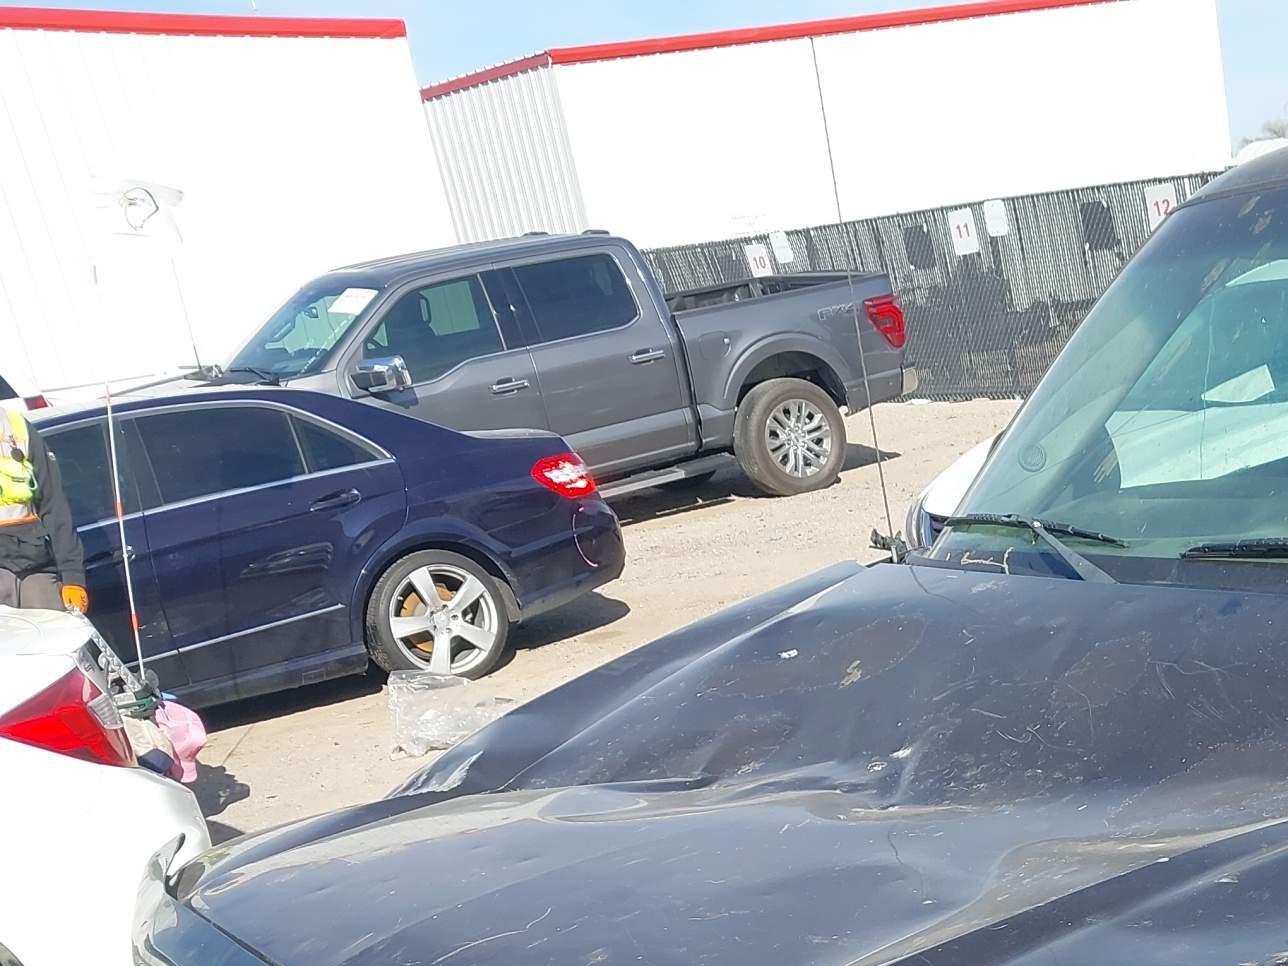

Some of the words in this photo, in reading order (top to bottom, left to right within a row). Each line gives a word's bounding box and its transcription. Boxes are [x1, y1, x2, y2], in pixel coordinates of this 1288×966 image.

[1153, 198, 1171, 217] 12
[955, 223, 971, 239] 11
[752, 256, 767, 270] 10
